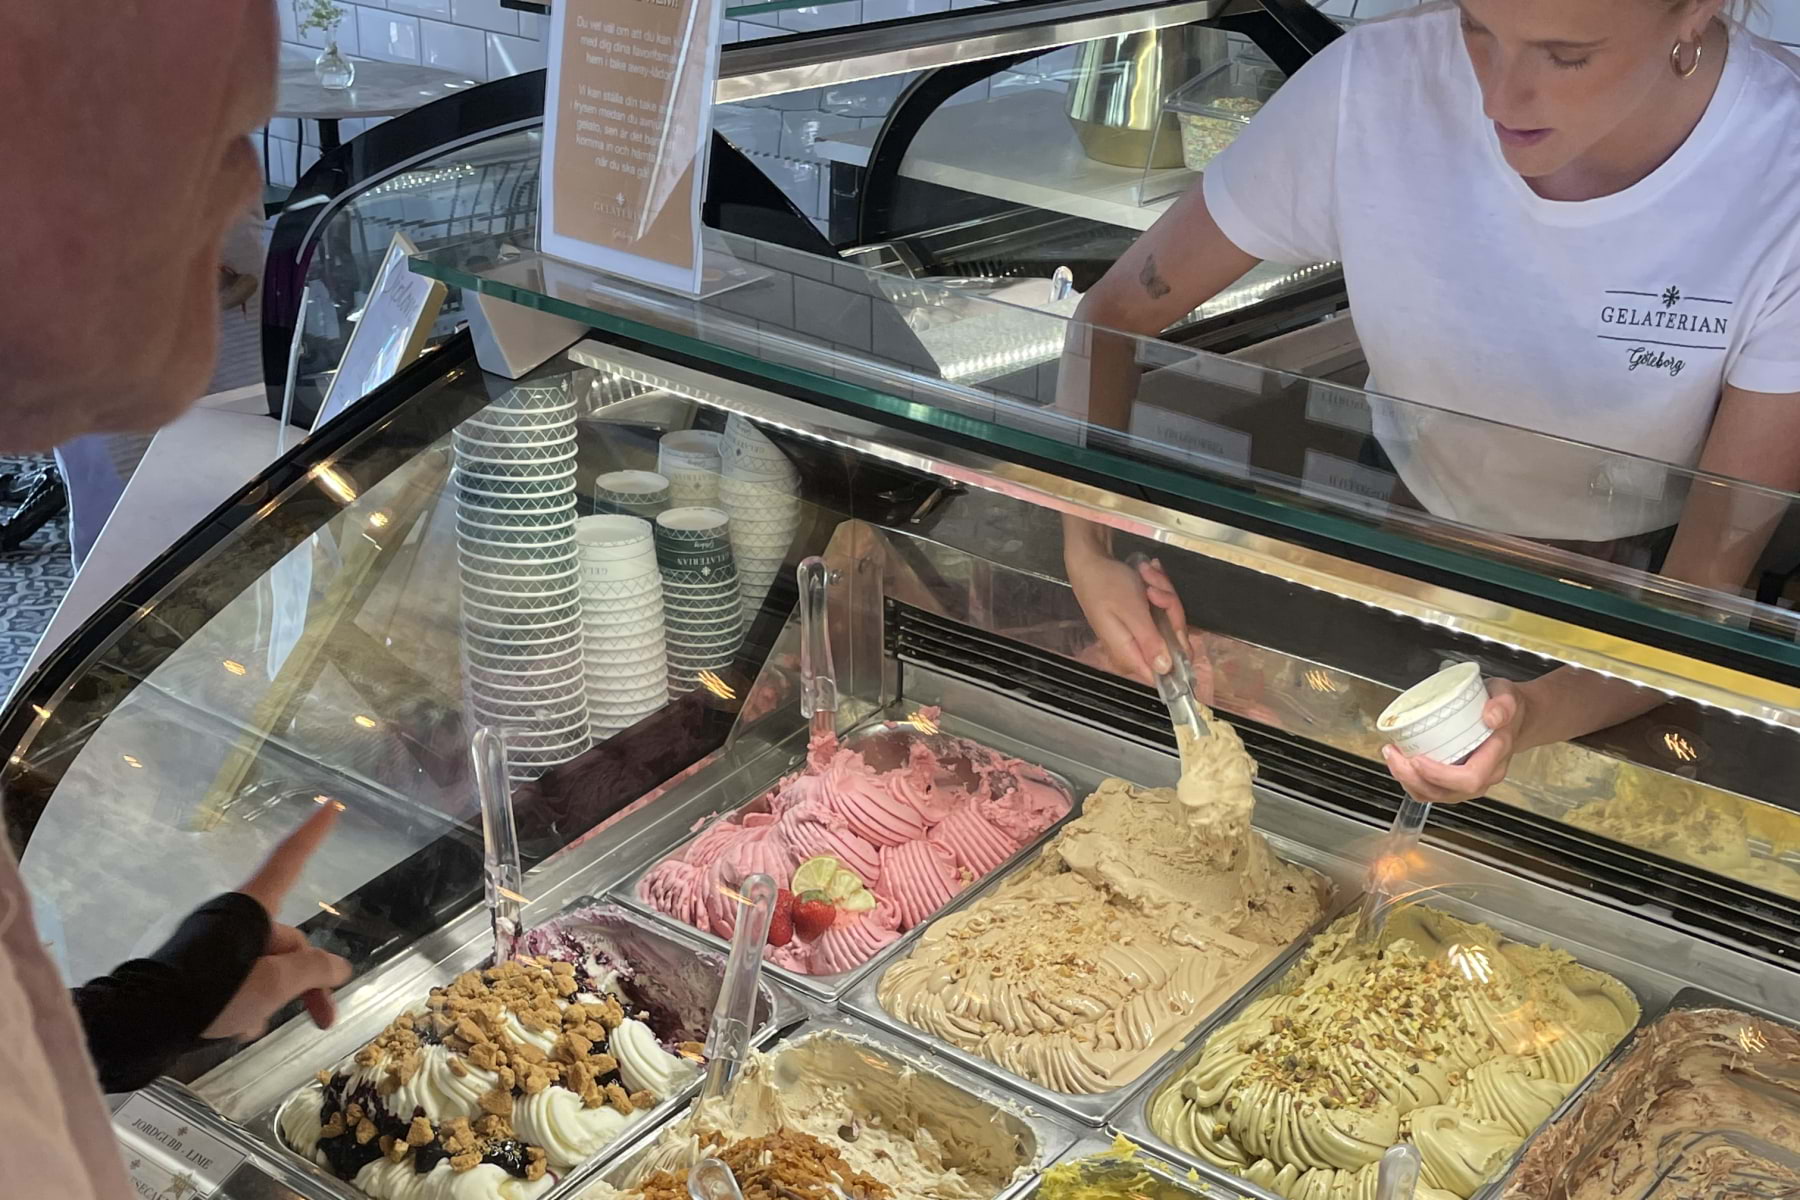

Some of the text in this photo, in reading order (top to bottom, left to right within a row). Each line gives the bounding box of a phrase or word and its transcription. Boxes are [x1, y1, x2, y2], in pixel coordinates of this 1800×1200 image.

[576, 15, 588, 28] Du
[616, 26, 630, 37] om
[631, 28, 642, 40] att
[643, 30, 655, 42] du
[656, 32, 672, 45] kan
[580, 36, 598, 48] med
[599, 38, 612, 54] dig
[613, 42, 631, 56] dina
[585, 51, 604, 65] hem
[609, 57, 627, 71] take
[574, 99, 597, 114] frysen
[598, 106, 626, 121] medan
[627, 113, 637, 124] du
[578, 84, 586, 96] Vi
[587, 86, 602, 99] kan
[603, 90, 624, 105] ställa
[625, 95, 638, 108] din
[639, 100, 657, 112] take
[576, 132, 604, 150] komma
[605, 143, 614, 152] in
[615, 144, 629, 156] och
[631, 147, 656, 163] hämta
[604, 126, 618, 137] sen
[619, 127, 628, 139] är
[629, 130, 643, 143] det
[595, 155, 609, 168] när
[609, 160, 620, 170] du
[621, 163, 635, 175] ska
[1601, 306, 1728, 335] GELATERIAN
[1626, 346, 1687, 377] Göteborg
[131, 1118, 183, 1153] JORDGUBB
[185, 1148, 214, 1171] LIME
